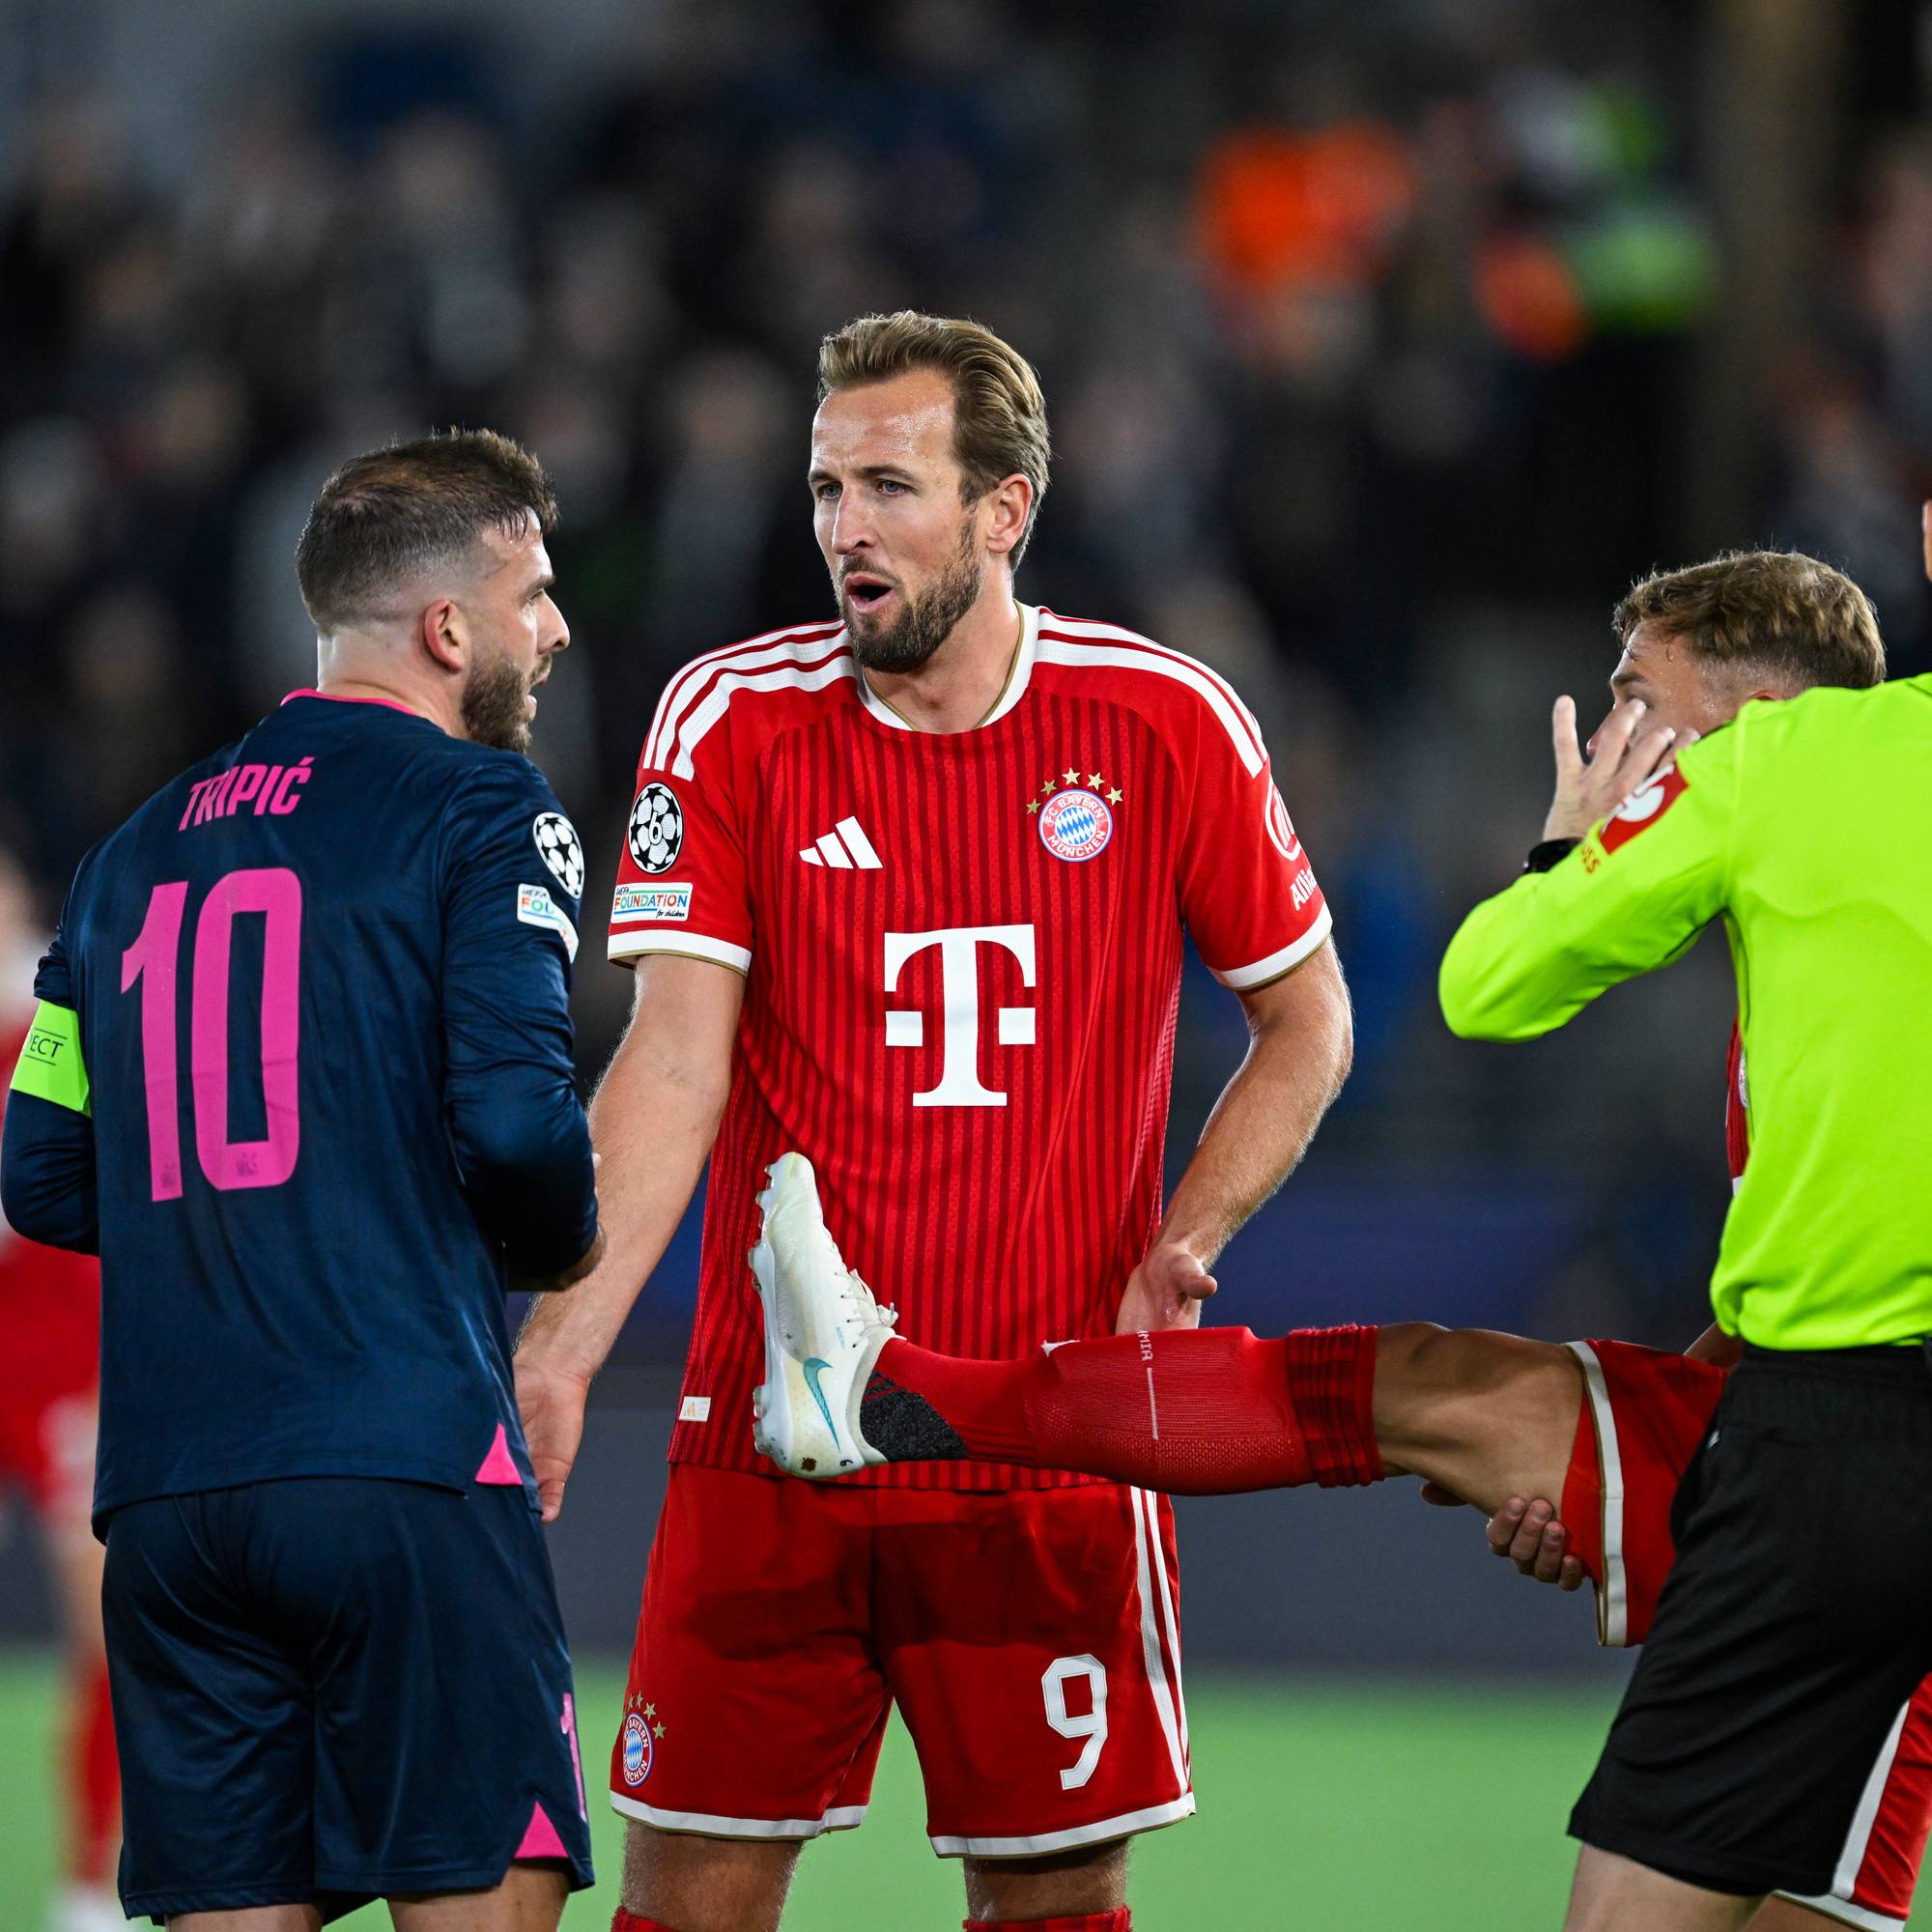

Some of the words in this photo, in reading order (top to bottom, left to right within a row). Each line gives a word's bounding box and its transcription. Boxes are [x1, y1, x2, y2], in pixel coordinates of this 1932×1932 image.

[178, 756, 315, 832] TRIPIĆ
[1044, 807, 1058, 827] FC
[1057, 795, 1106, 820] BAYERN
[648, 810, 663, 845] 6
[1047, 831, 1106, 857] MÜNCHEN
[614, 895, 688, 910] FOUNDATION
[121, 867, 302, 1202] 10
[884, 923, 1037, 1107] T
[1041, 1654, 1108, 1791] 9
